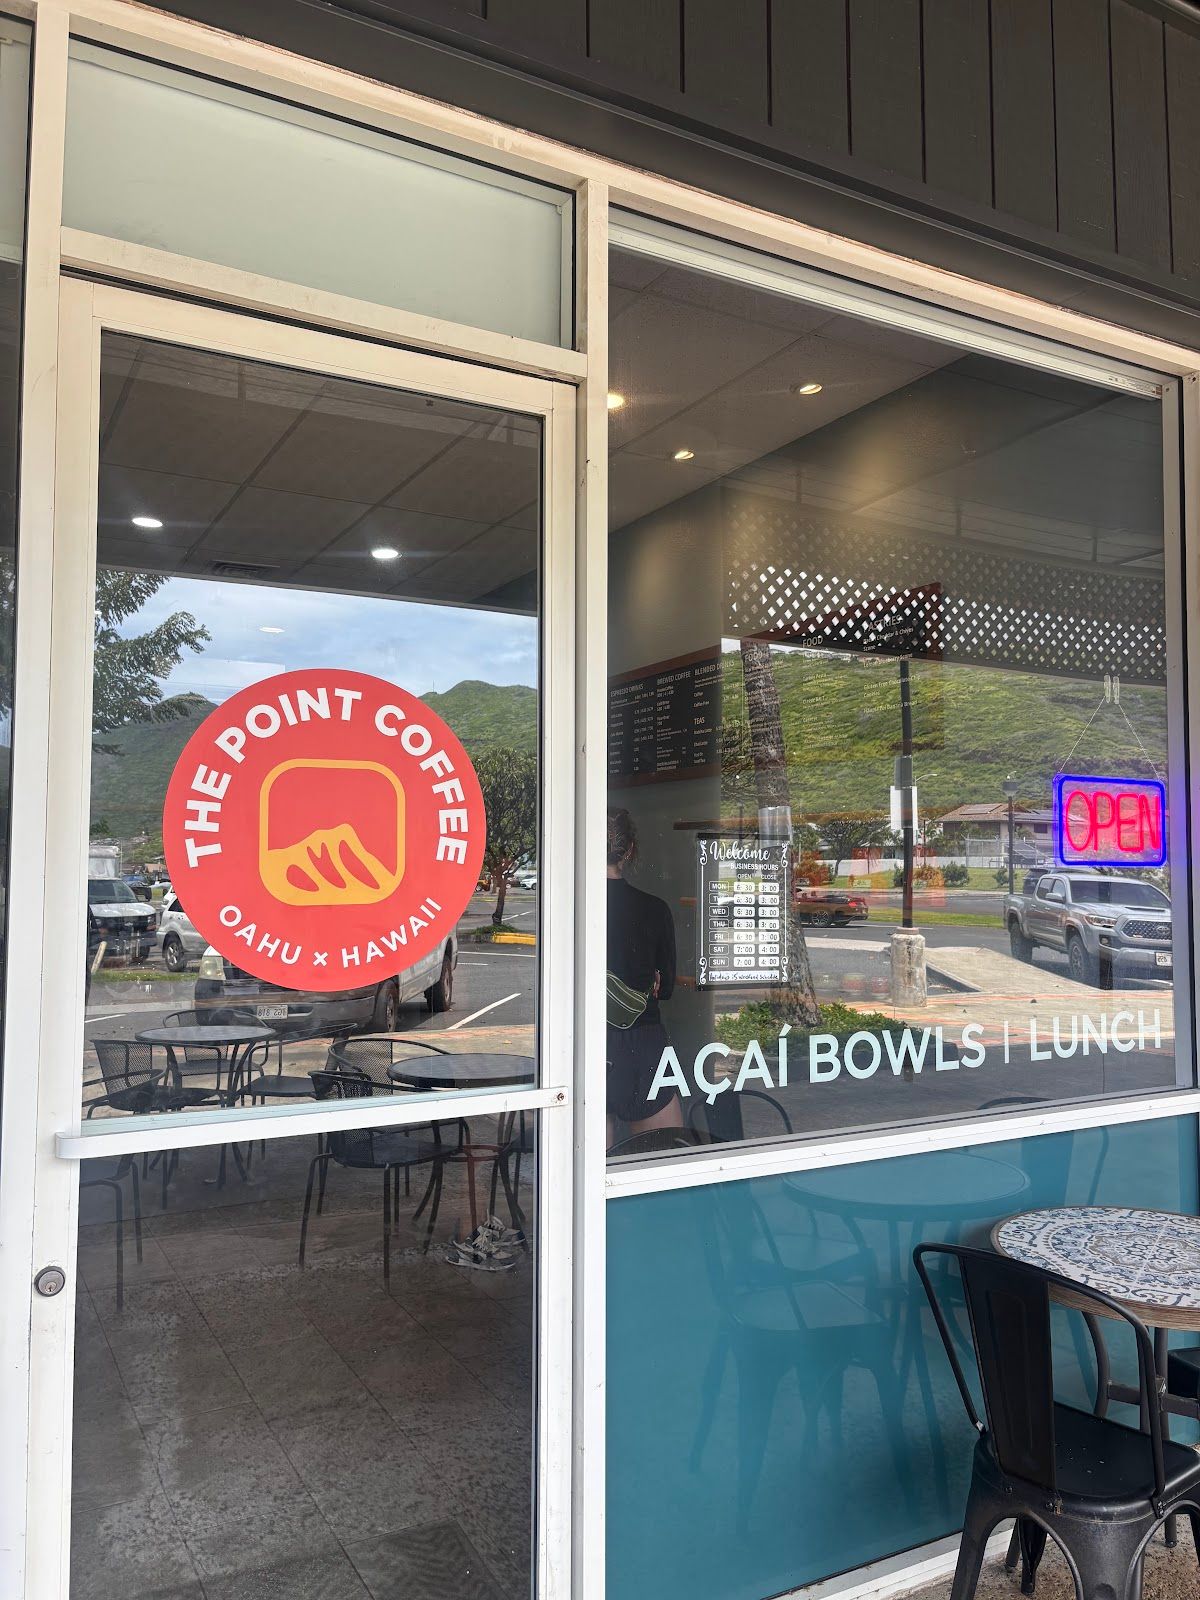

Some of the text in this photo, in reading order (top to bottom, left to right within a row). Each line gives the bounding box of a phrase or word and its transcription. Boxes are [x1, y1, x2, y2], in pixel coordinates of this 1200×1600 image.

[864, 615, 901, 632] ASTRIES
[802, 637, 823, 648] FOOD
[694, 665, 716, 676] BLENDED
[184, 687, 469, 868] THE POINT COFFEE
[1065, 791, 1160, 852] OPEN
[710, 841, 771, 861] Welcome
[759, 863, 779, 871] HOURS
[219, 905, 302, 965] OAHU
[341, 897, 442, 968] HAWAII
[646, 1023, 793, 1106] AÇAÍ
[809, 1023, 985, 1084] BOWLS
[1030, 1008, 1161, 1061] LUNCH
